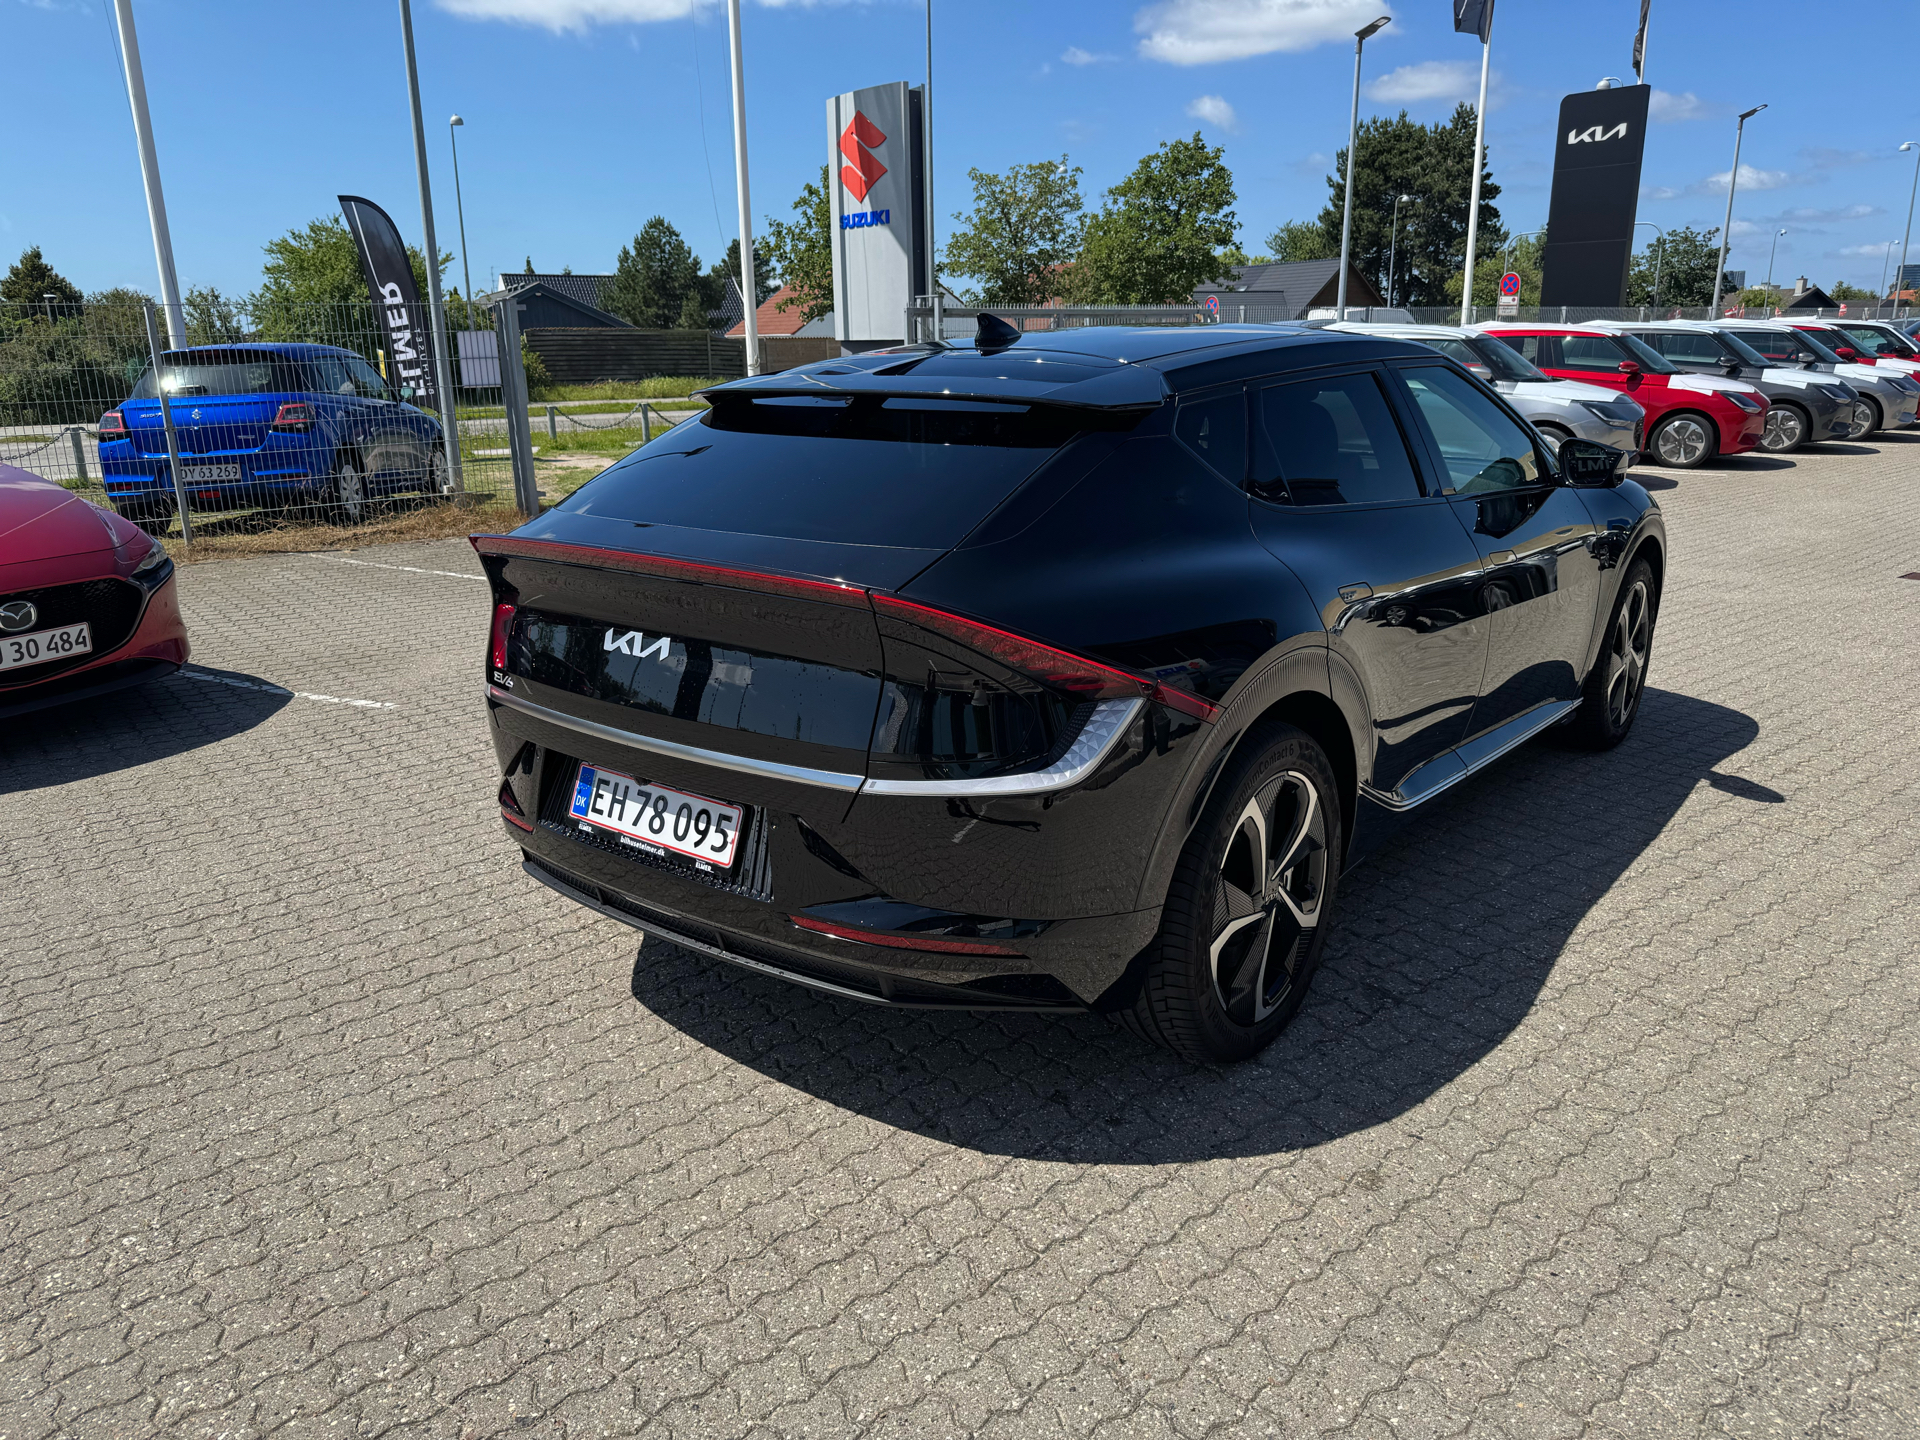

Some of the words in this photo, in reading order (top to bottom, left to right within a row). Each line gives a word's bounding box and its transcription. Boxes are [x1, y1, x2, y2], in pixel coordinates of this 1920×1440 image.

[1567, 122, 1627, 145] KIA
[840, 209, 890, 230] SUZUKI
[199, 465, 213, 479] 63
[217, 464, 238, 478] 269
[9, 638, 40, 663] 30
[46, 627, 88, 654] 484
[603, 627, 671, 662] KIA
[493, 671, 514, 688] EV6
[575, 794, 588, 808] DK
[590, 776, 630, 823] EH
[631, 788, 669, 835] 78
[673, 801, 733, 853] 095
[620, 835, 665, 858] bilhusetelmer.dk
